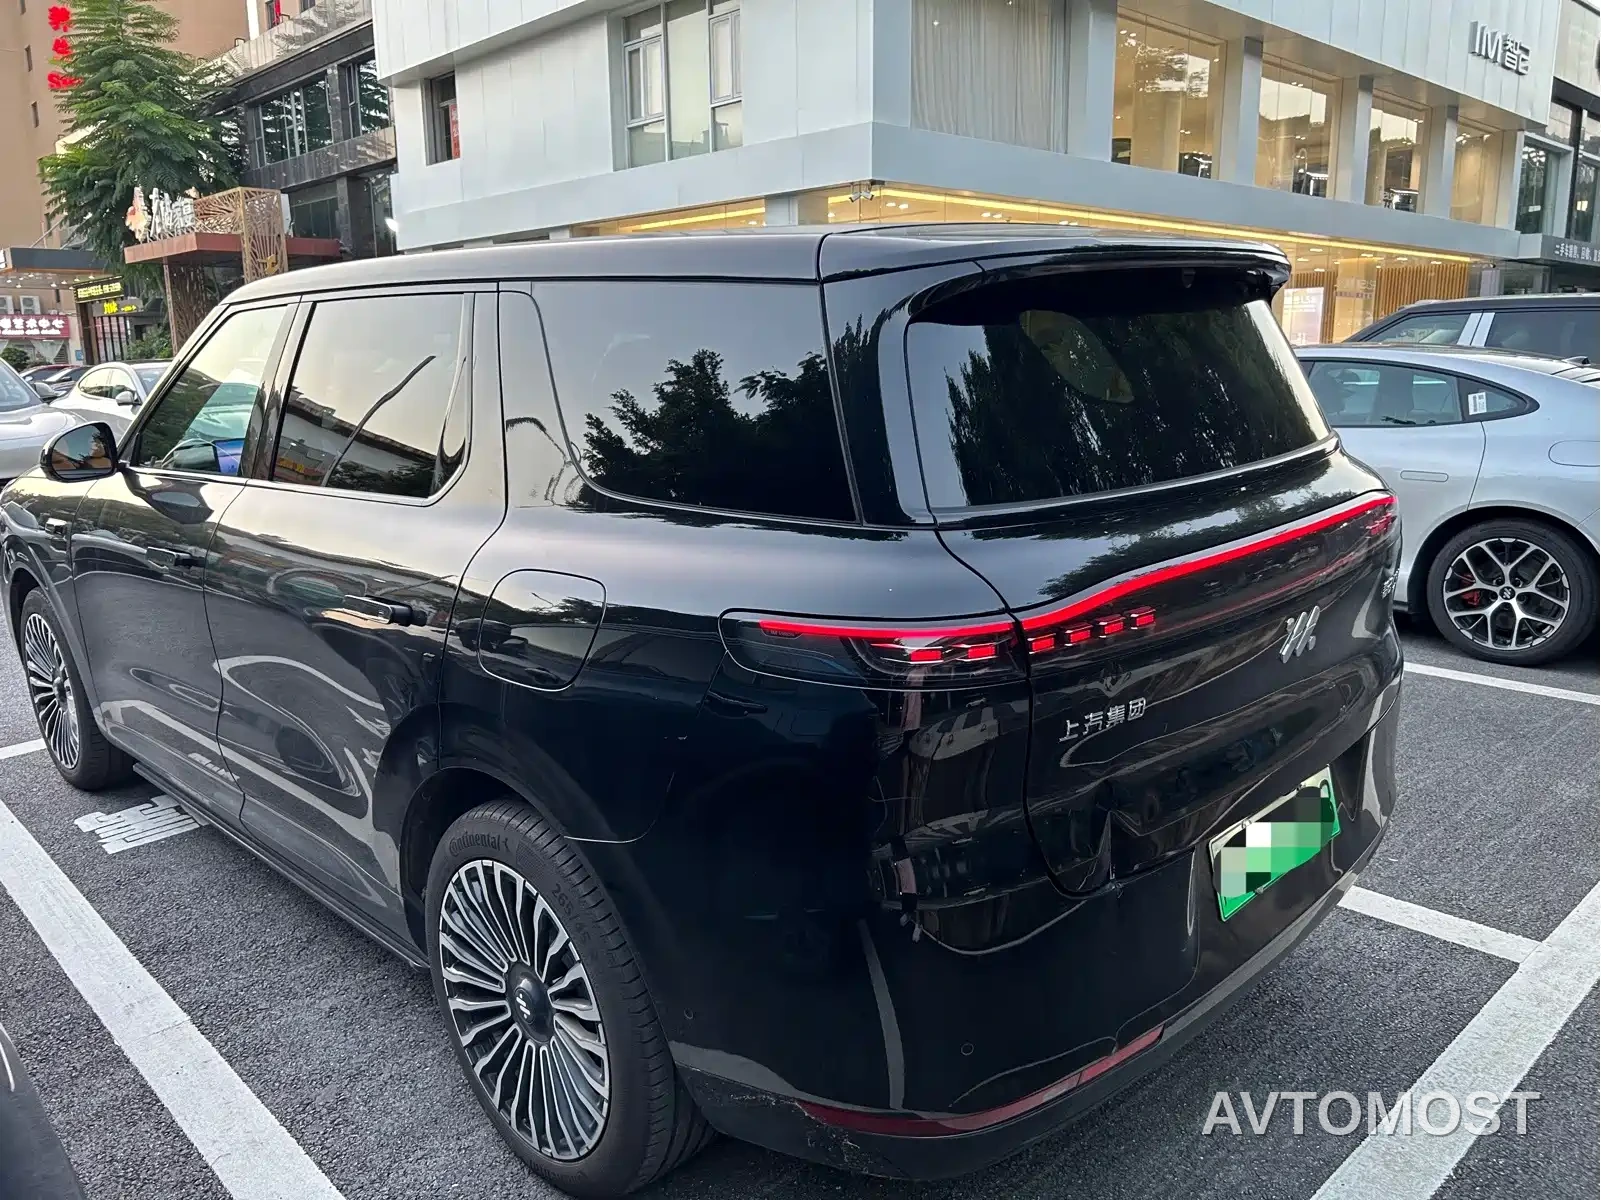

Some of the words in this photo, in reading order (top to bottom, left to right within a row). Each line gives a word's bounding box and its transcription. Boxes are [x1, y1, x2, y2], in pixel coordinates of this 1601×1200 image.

[1059, 697, 1146, 742] 上汽集团
[449, 831, 501, 857] Continental
